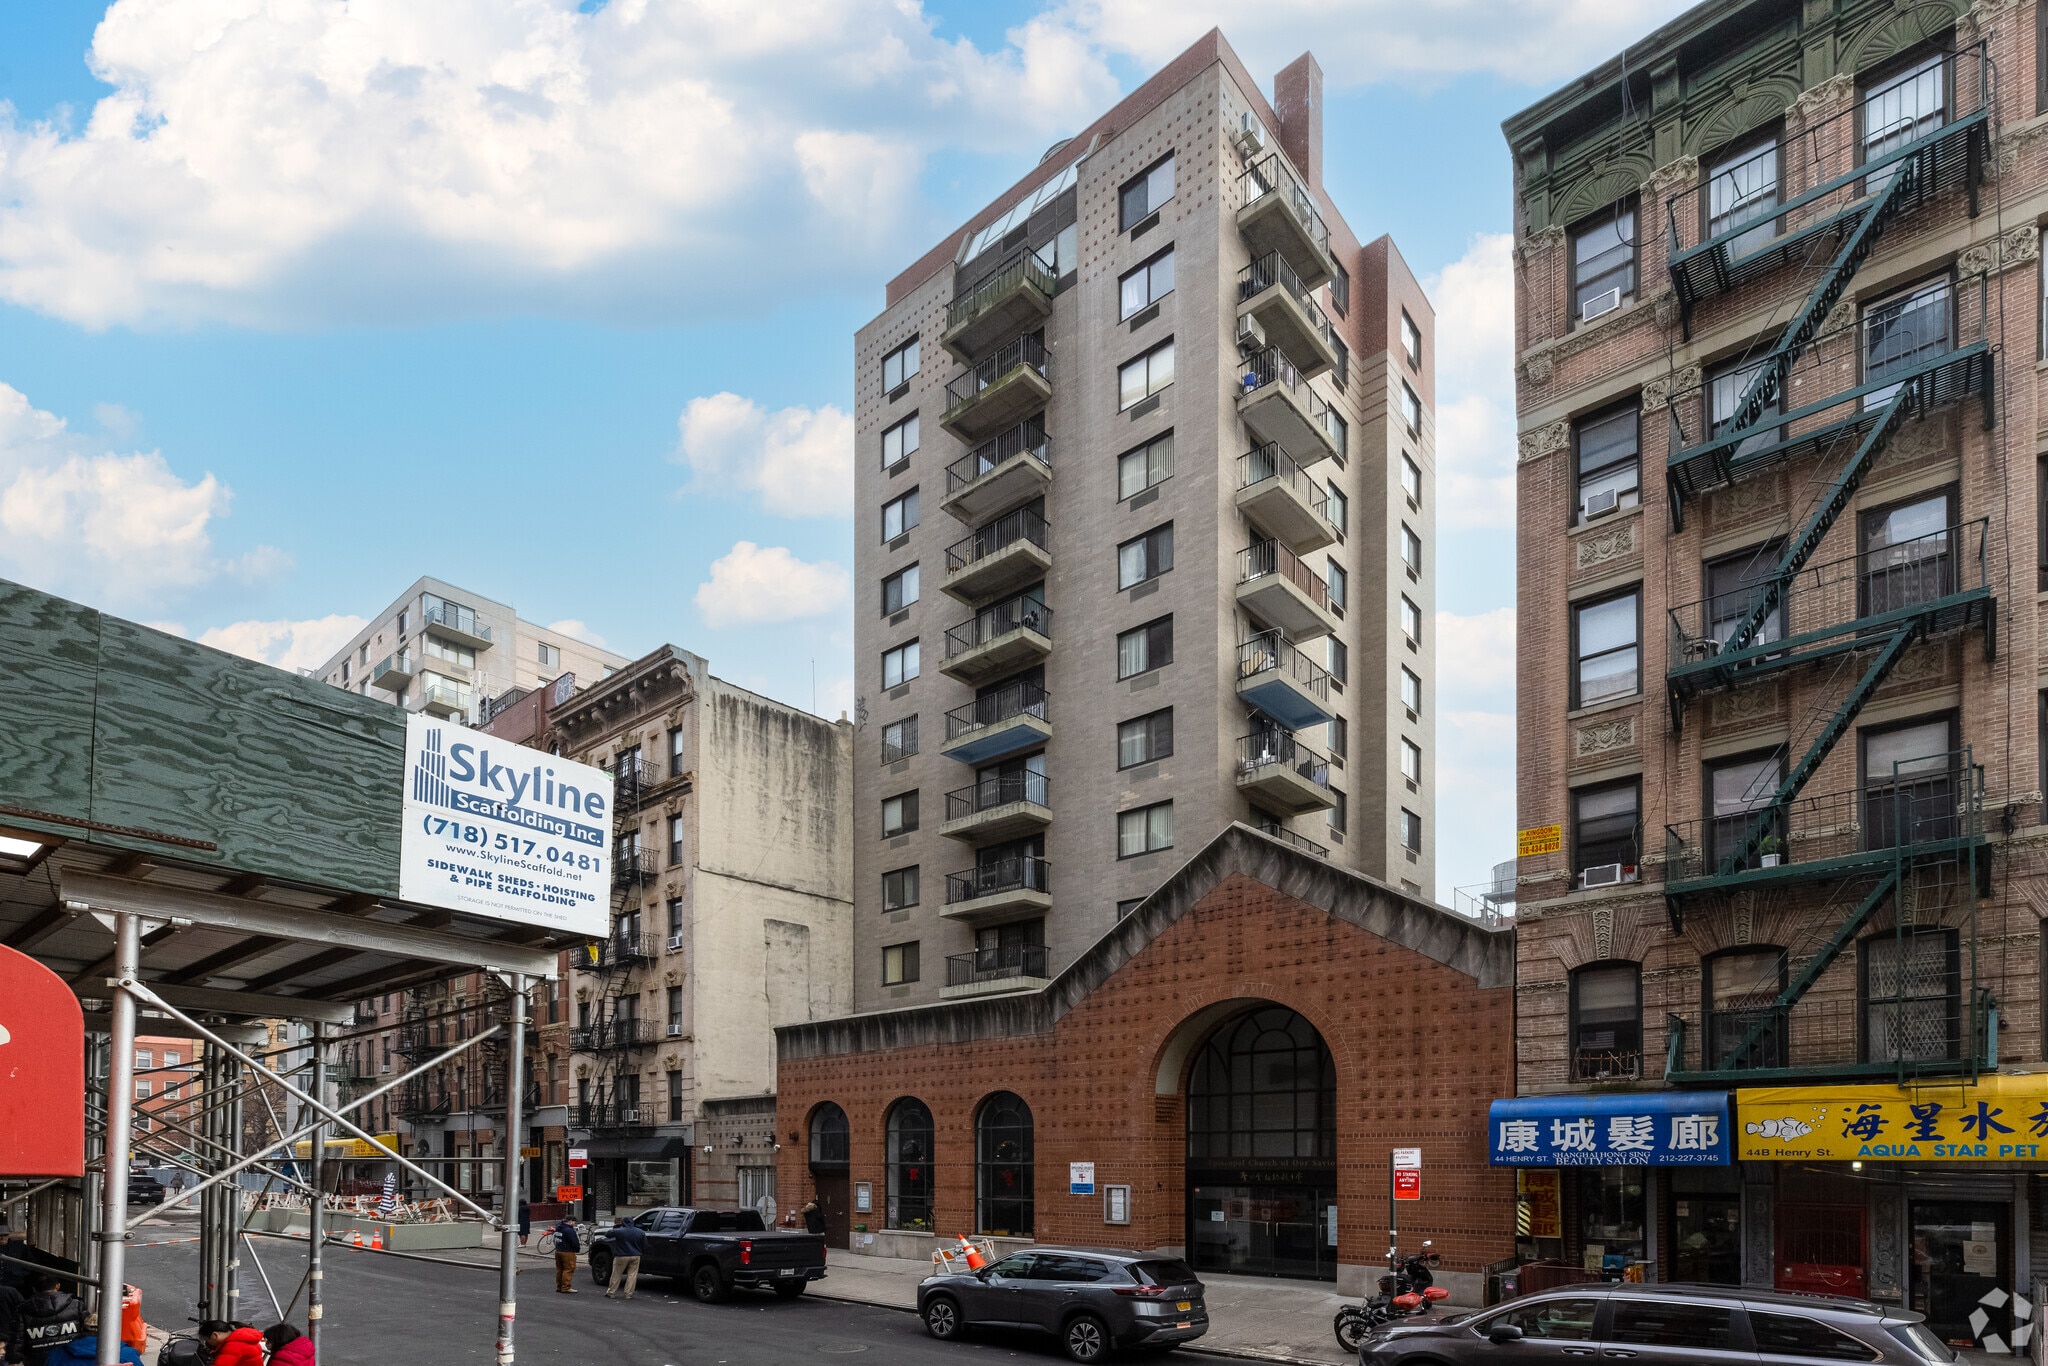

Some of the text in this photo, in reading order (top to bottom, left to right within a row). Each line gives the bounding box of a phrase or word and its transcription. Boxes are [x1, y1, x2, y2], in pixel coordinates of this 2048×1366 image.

[450, 743, 605, 819] Skyline
[423, 814, 488, 848] (718)
[456, 793, 601, 844] Scaffolding Inc.
[446, 844, 582, 882] www.SkylineScaffold.net
[427, 859, 596, 902] SIDEWALK SHEDS HOISTING
[449, 874, 576, 907] & PIPE SCAFFOLDING
[457, 895, 484, 905] STORAGE
[491, 901, 503, 909] NOT
[504, 903, 532, 915] PERMITTED
[554, 912, 567, 921] SHED
[1497, 1114, 1720, 1153] 康城髮廊
[1249, 1159, 1278, 1167] Church
[1281, 1159, 1289, 1167] of
[1292, 1159, 1308, 1167] Our
[1555, 1157, 1648, 1166] BEAUTY SALON
[1659, 1154, 1719, 1162] 212-227-3745
[1776, 1148, 1811, 1158] Henry
[1816, 1148, 1834, 1157] St.
[1857, 1144, 2040, 1157] AQUA STAR PET
